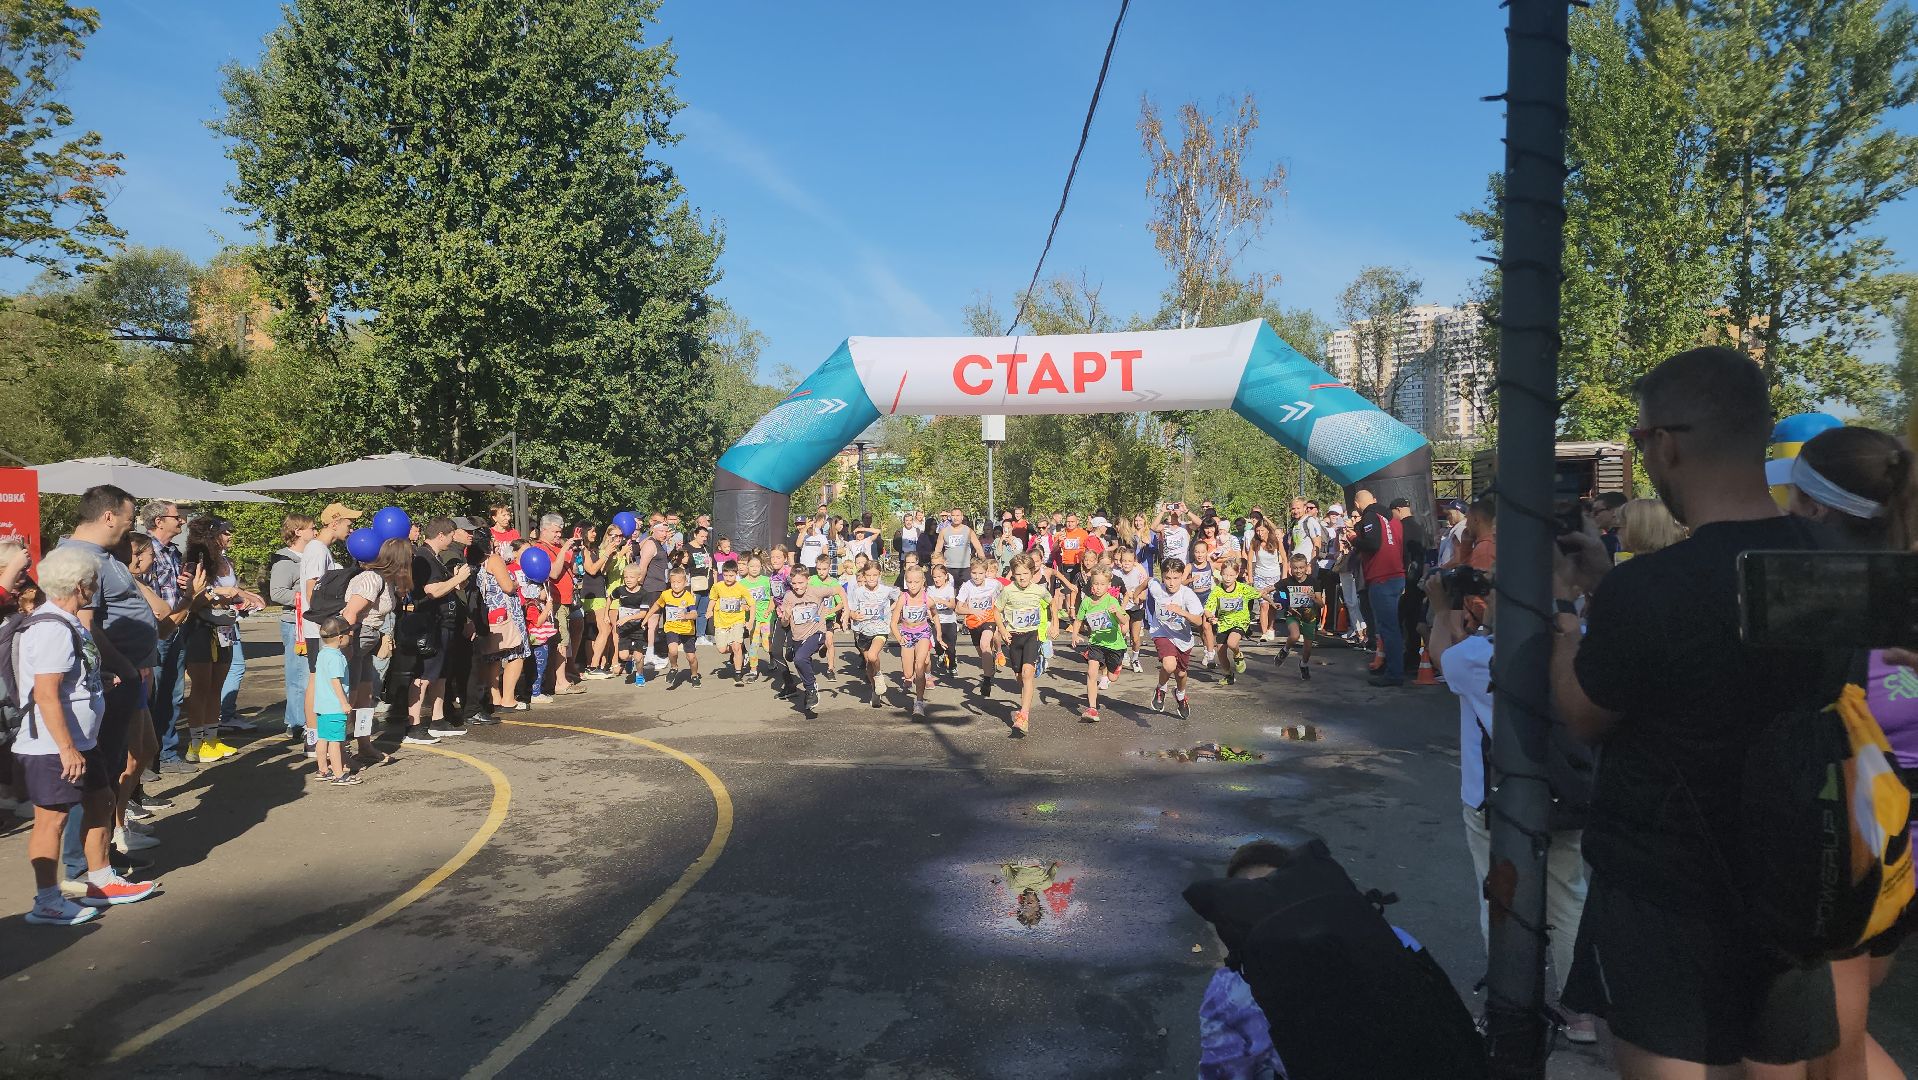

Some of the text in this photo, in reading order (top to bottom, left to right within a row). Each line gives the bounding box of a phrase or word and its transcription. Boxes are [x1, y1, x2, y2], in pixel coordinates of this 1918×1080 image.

[953, 350, 1142, 395] СТАРТ
[800, 611, 812, 620] 13
[864, 608, 880, 616] 112
